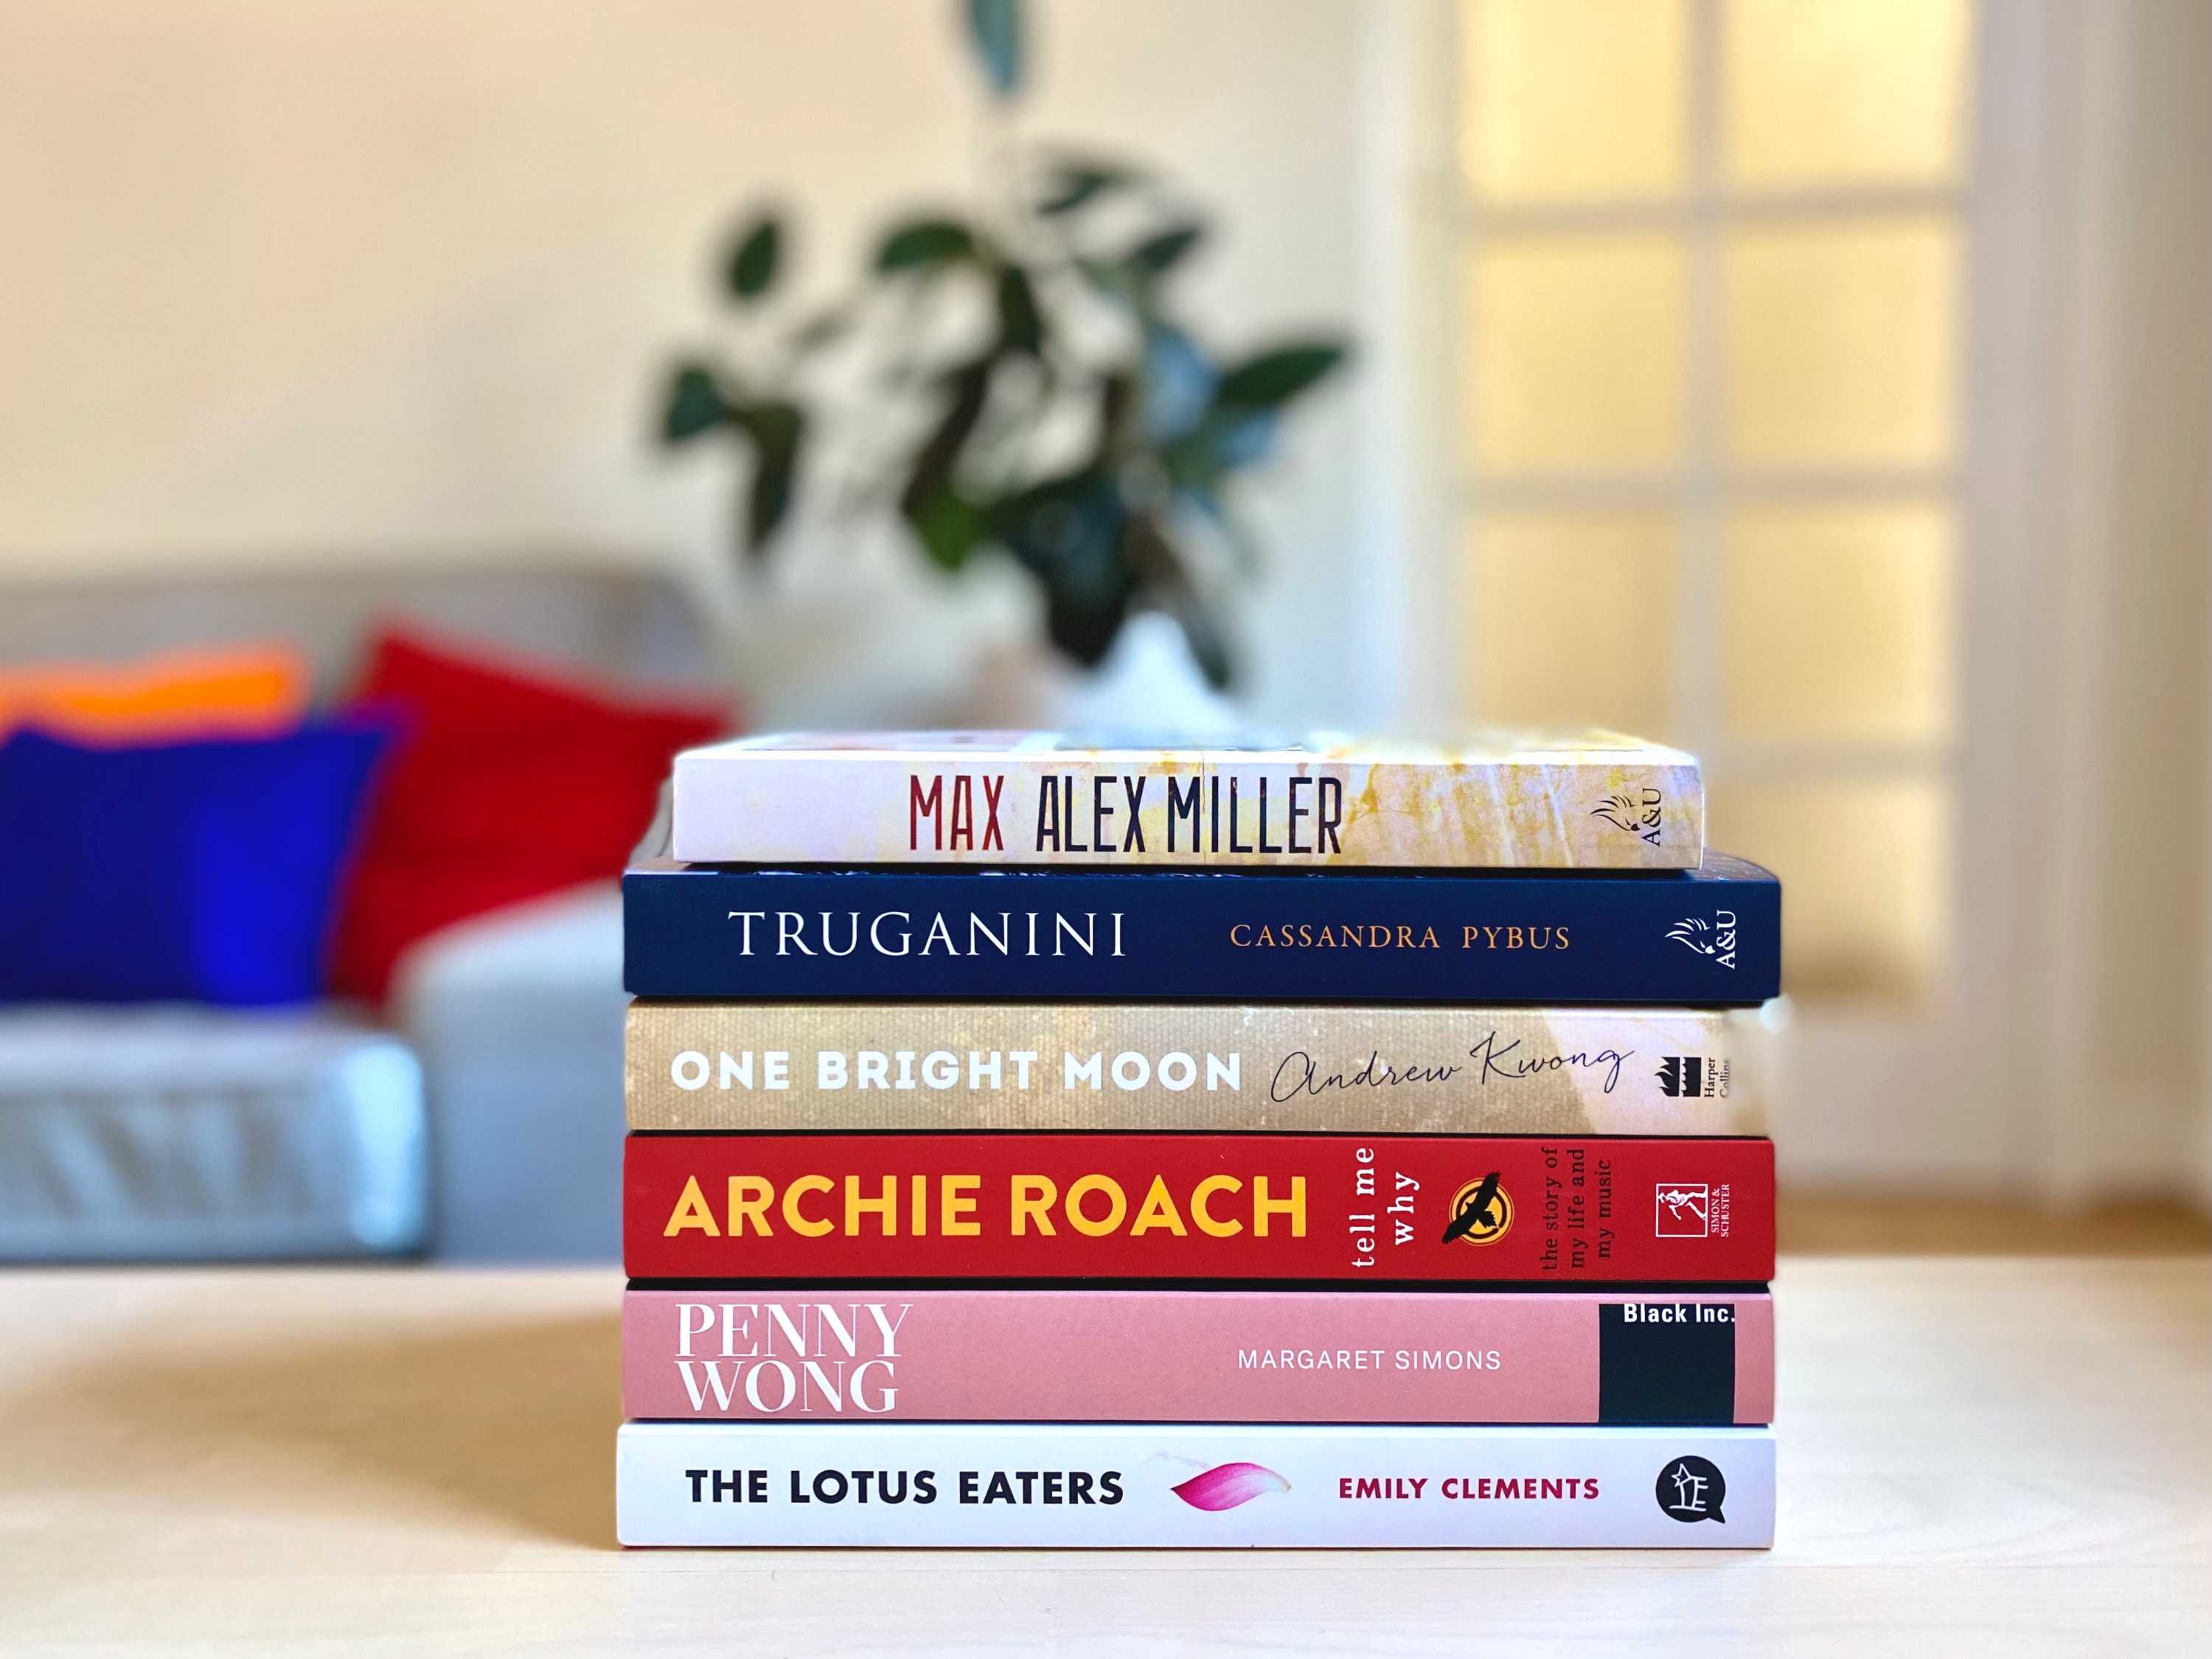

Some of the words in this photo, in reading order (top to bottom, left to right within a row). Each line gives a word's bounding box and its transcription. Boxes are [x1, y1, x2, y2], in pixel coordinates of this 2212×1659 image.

[909, 774, 1005, 851] MAX
[1035, 775, 1147, 852] ALEX
[1166, 776, 1343, 854] MILLER
[1641, 787, 1662, 847] A&U
[728, 911, 1127, 957] TRUGANINI
[1230, 924, 1441, 949] CASSANDRA
[1462, 926, 1570, 950] PYBUS
[1716, 909, 1736, 970] A&U
[671, 1050, 790, 1091] ONE
[818, 1050, 1039, 1091] BRIGHT
[1064, 1051, 1240, 1091] MOON
[1270, 1051, 1462, 1103] Andrew
[1469, 1031, 1635, 1093] Kwong
[1704, 1057, 1719, 1097] Harper
[1356, 1147, 1374, 1196] me
[1541, 1147, 1558, 1168] of
[1567, 1148, 1585, 1186] and
[664, 1174, 981, 1237] ARCHIE
[1010, 1174, 1307, 1237] ROACH
[1387, 1172, 1420, 1245] why
[1543, 1177, 1562, 1230] story
[1594, 1160, 1611, 1218] music
[1711, 1187, 1720, 1196] &
[1721, 1183, 1730, 1238] SCHUSTER
[1568, 1195, 1585, 1228] life
[1711, 1198, 1720, 1234] SIMON
[1349, 1214, 1375, 1267] tell
[1540, 1239, 1557, 1270] the
[1571, 1238, 1588, 1269] my
[1599, 1228, 1615, 1259] my
[675, 1304, 914, 1357] PENNY
[1624, 1303, 1687, 1323] Black
[1696, 1303, 1736, 1323] Inc.
[1237, 1349, 1385, 1370] MARGARET
[1394, 1350, 1502, 1371] SIMONS
[675, 1360, 900, 1413] WONG
[686, 1470, 768, 1503] THE
[791, 1470, 938, 1504] LOTUS
[959, 1471, 1124, 1505] EATERS
[1339, 1478, 1429, 1499] EMILY
[1441, 1478, 1600, 1500] CLEMENTS
